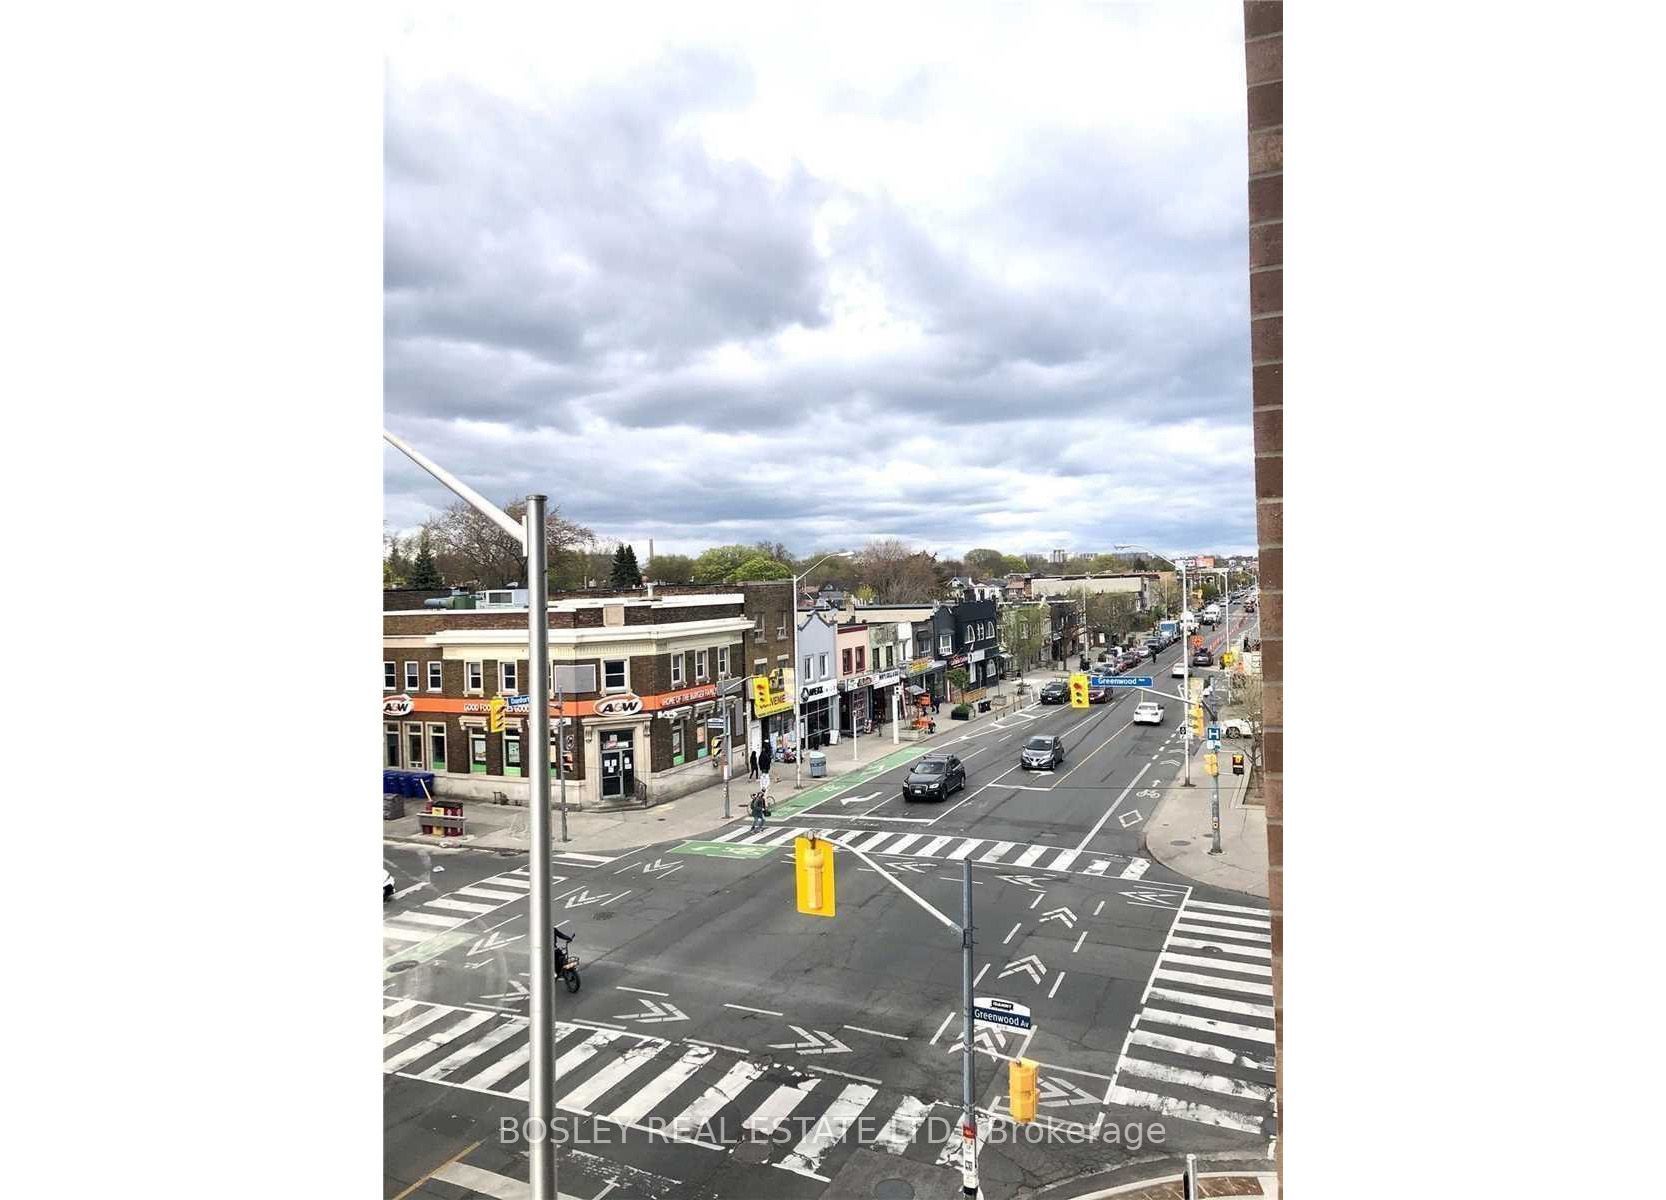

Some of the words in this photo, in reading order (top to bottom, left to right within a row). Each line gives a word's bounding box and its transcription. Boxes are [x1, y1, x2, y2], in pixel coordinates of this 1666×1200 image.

[384, 703, 408, 712] A&W
[464, 704, 479, 712] GOOD
[480, 704, 491, 712] FOO
[602, 701, 639, 713] A&W
[1209, 729, 1219, 738] H
[974, 1009, 1019, 1025] Greenwood
